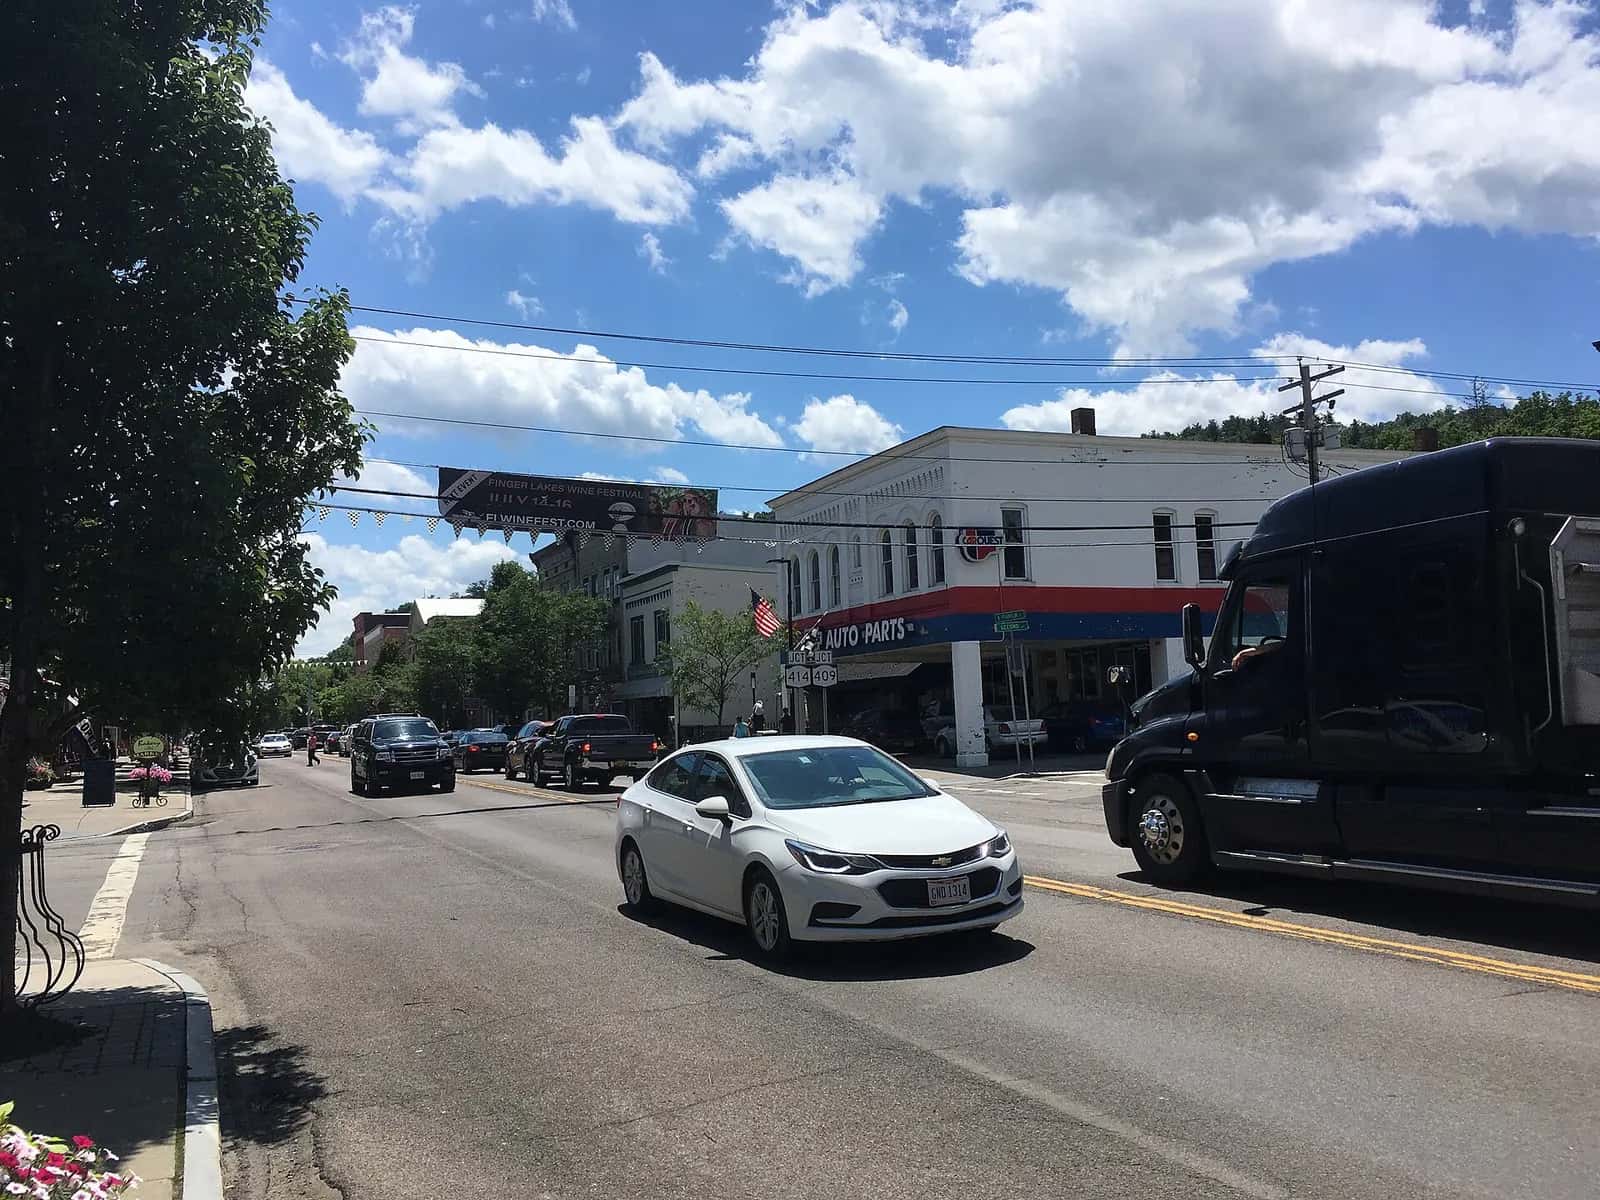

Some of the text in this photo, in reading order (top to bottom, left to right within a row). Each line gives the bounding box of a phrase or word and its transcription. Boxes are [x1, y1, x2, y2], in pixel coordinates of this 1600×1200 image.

[457, 474, 478, 493] EVENT
[488, 478, 645, 500] FINGER LAKES WINE FESTIVAL
[825, 617, 905, 650] AUTO PARTS
[790, 652, 831, 662] JCT JCT
[788, 670, 836, 682] 414 409
